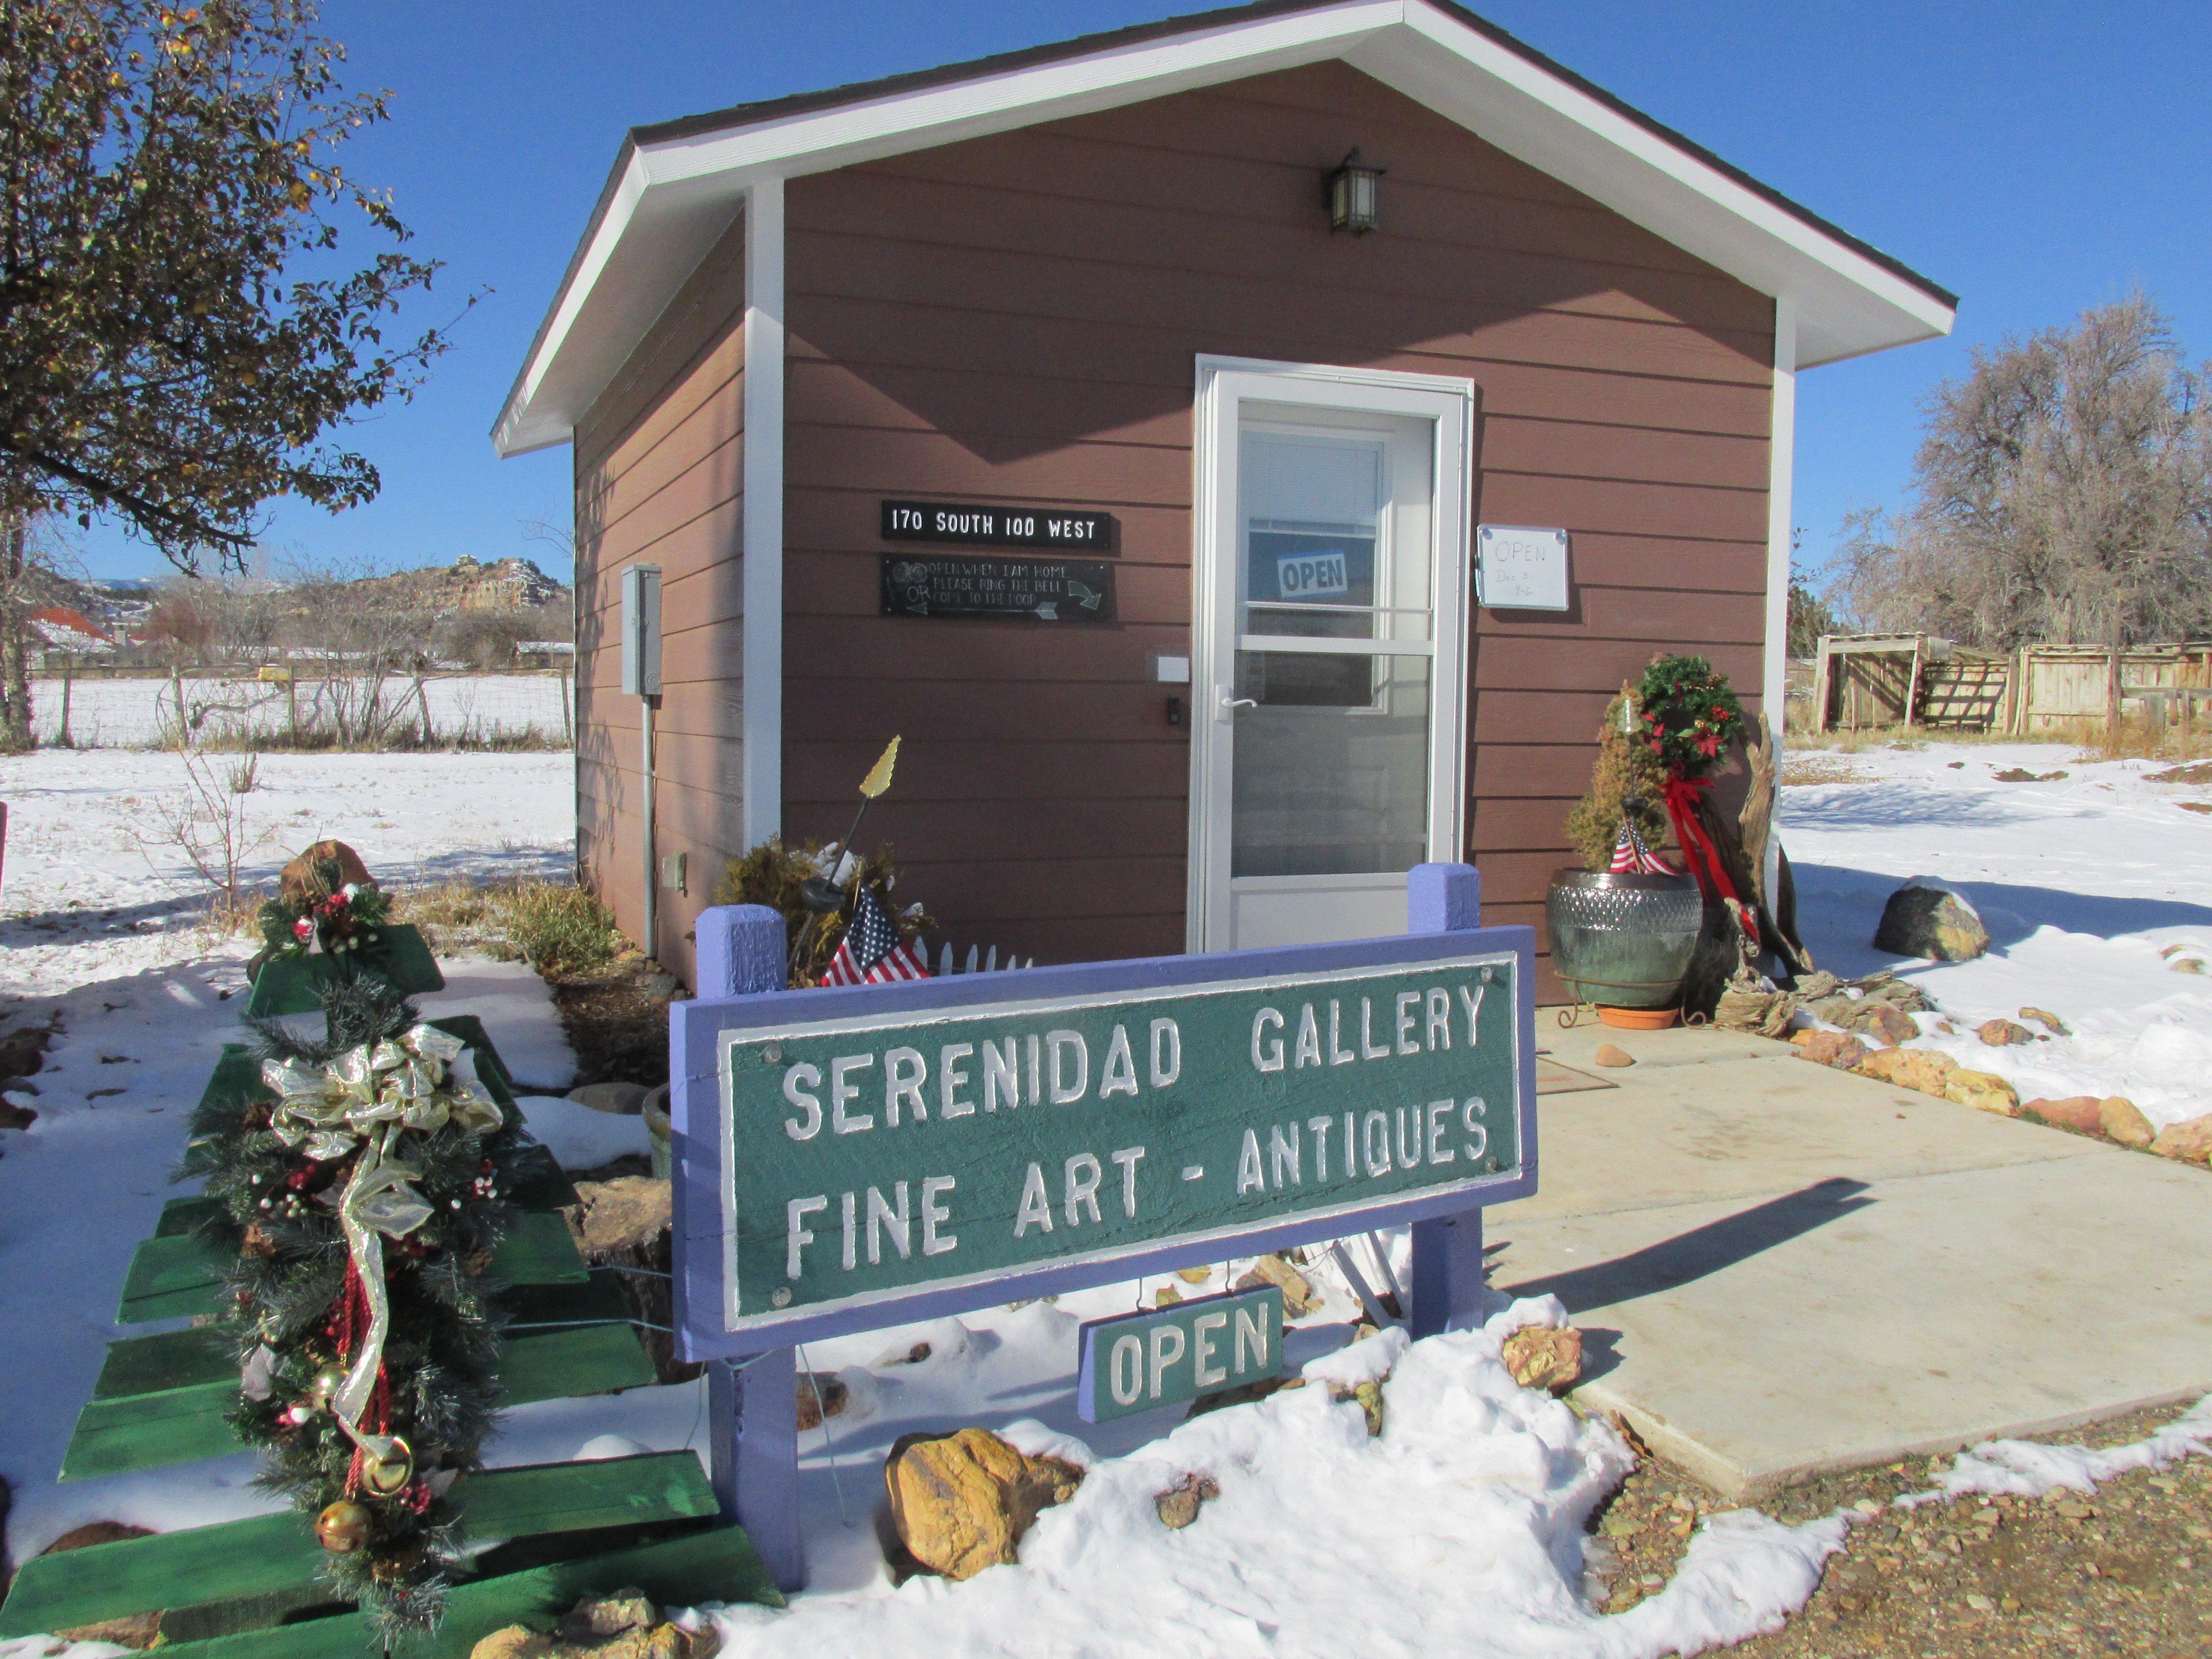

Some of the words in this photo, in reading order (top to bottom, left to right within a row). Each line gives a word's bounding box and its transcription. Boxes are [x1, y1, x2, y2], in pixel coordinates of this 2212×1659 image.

[892, 509, 922, 530] 170
[936, 511, 993, 535] SOUTH
[1006, 517, 1034, 537] 100
[1047, 519, 1095, 540] WEST
[1495, 541, 1546, 562] OPEN
[928, 562, 960, 575] OPEN
[962, 563, 997, 576] WHEN
[1002, 565, 1009, 577] I
[1011, 565, 1028, 577] AM
[934, 577, 973, 591] PLEASE
[979, 579, 1005, 591] RING
[1011, 579, 1029, 592] THE
[1035, 580, 1060, 592] BELL
[1282, 559, 1344, 591] OPEN
[907, 584, 931, 602] OR
[970, 592, 982, 604] TO
[986, 593, 1003, 605] THE
[782, 1017, 1181, 1141] SERENIDAD
[1251, 985, 1484, 1072] GALLERY
[786, 1174, 958, 1279] FINE
[1013, 1145, 1145, 1238] ART
[1182, 1165, 1203, 1181] -
[1236, 1095, 1487, 1197] ANTIQUES
[1110, 1302, 1268, 1406] OPEN
